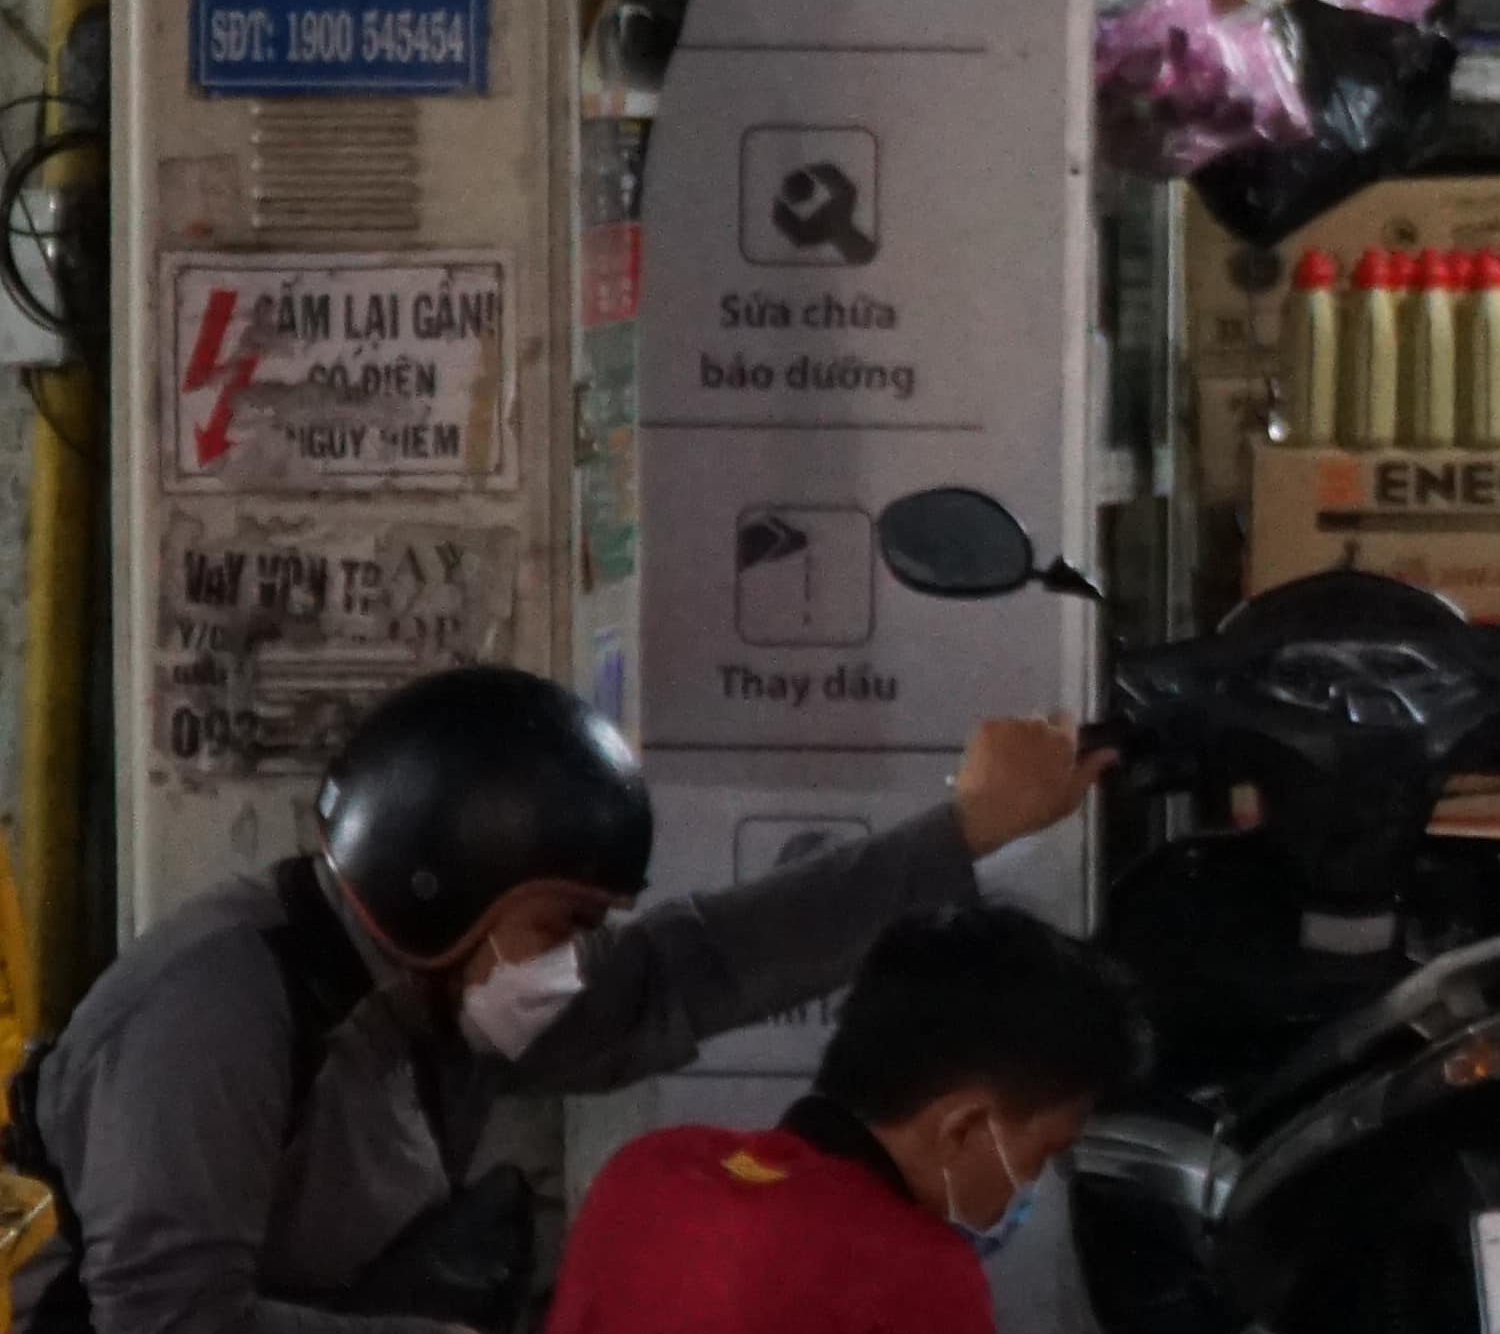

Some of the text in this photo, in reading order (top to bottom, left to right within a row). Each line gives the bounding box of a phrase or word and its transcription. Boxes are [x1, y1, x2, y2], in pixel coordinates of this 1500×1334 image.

[210, 10, 465, 63] SĐT: 1900 545454
[720, 663, 808, 708] Thay
